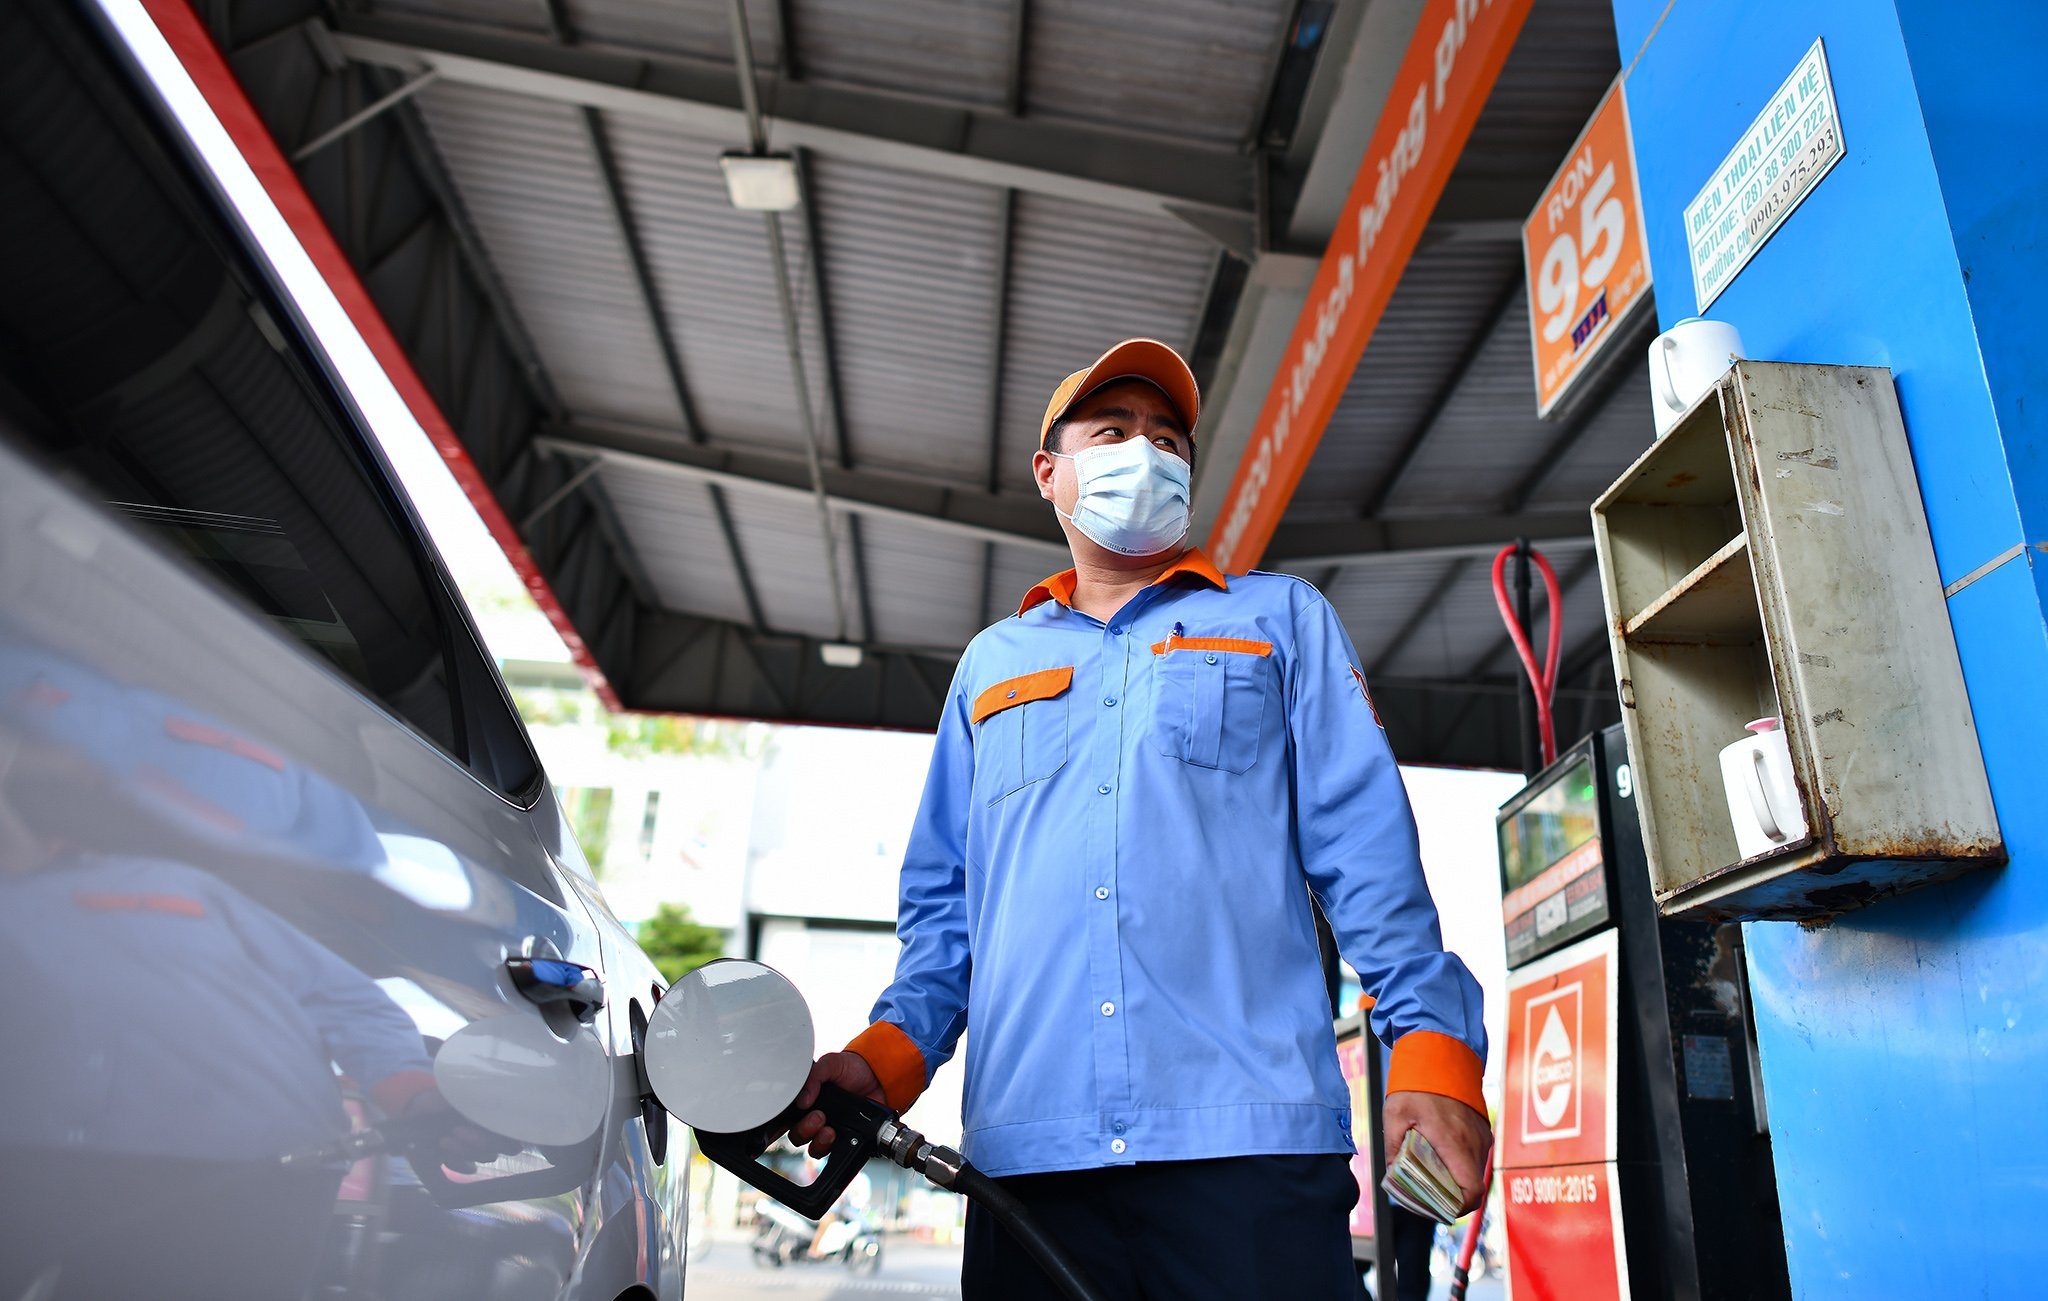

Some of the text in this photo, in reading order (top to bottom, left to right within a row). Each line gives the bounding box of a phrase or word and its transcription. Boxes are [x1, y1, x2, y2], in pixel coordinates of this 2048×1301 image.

[1358, 80, 1427, 268] hàng
[1434, 0, 1493, 115] ph
[1547, 145, 1594, 233] RON
[1693, 62, 1819, 234] ĐIỆN THOẠI LIÊN HỆ
[1697, 100, 1826, 267] HOTLINE: (28) 38 300 222
[1750, 128, 1834, 235] 0903.975.293
[1538, 160, 1625, 343] 95
[1510, 1174, 1597, 1205] ISO 9001:2015
